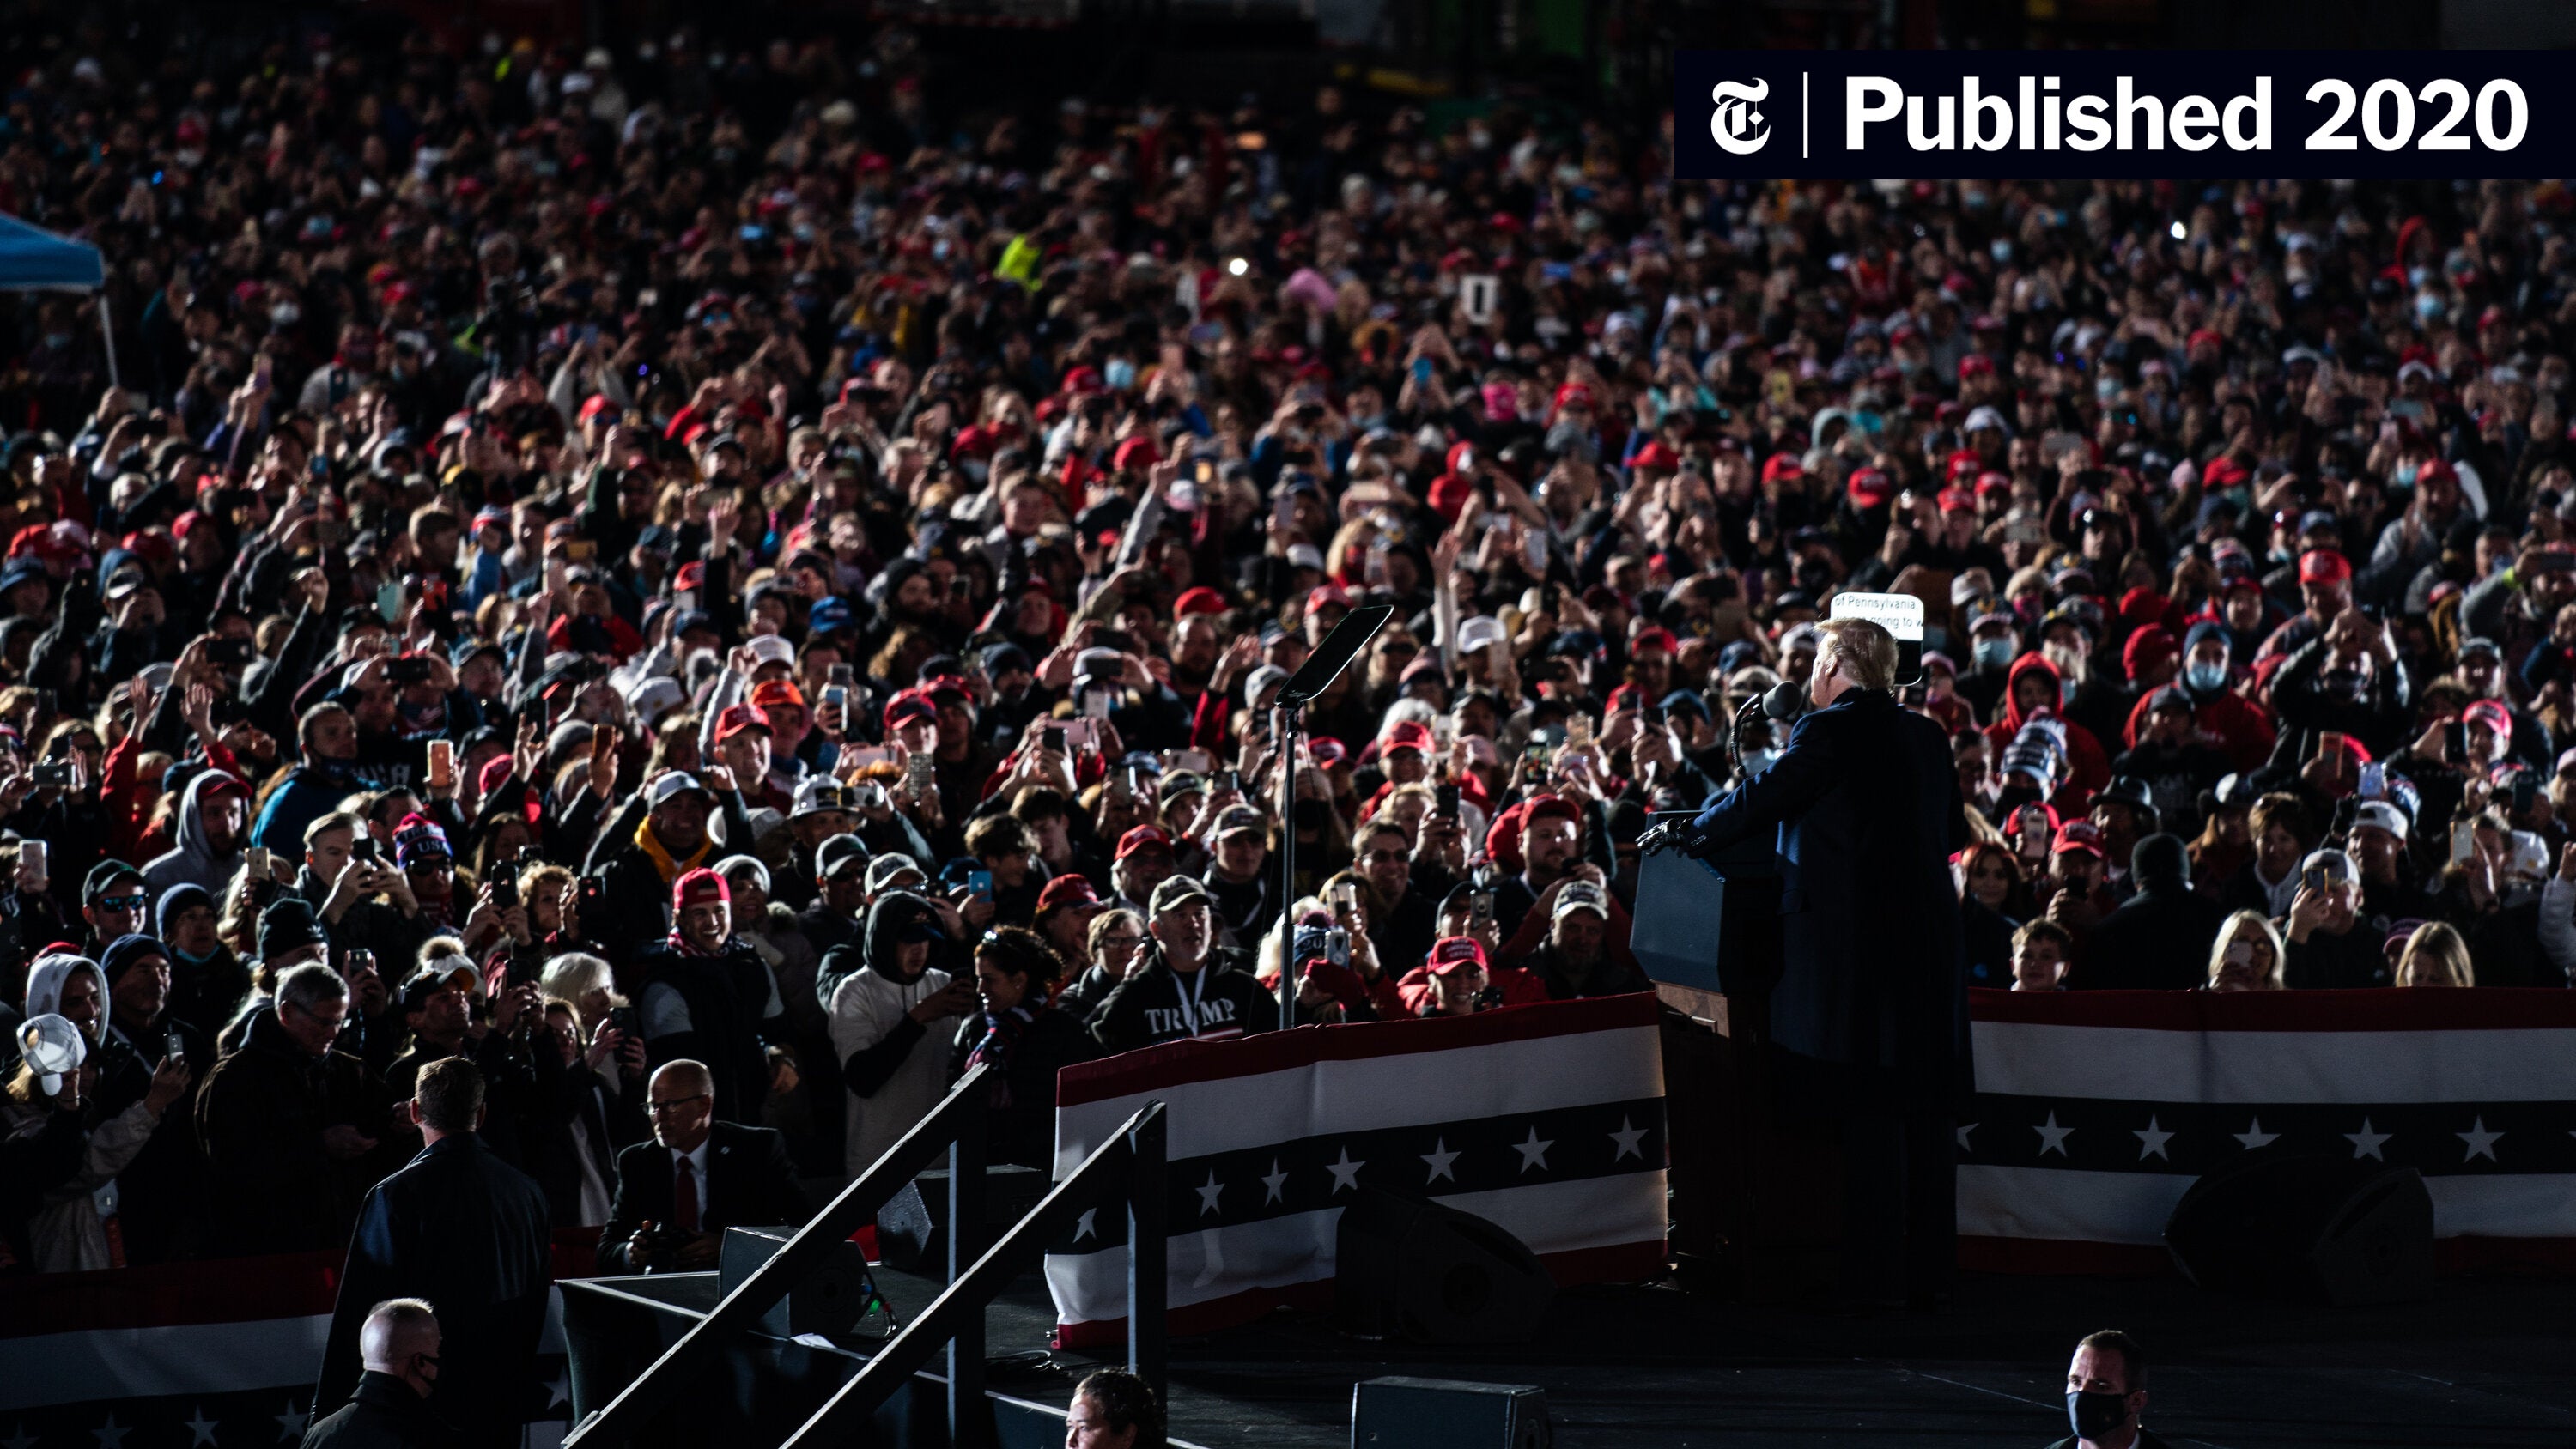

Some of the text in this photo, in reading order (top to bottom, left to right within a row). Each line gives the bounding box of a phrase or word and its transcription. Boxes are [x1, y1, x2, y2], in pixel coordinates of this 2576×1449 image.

[1835, 595, 1845, 606] of
[1903, 616, 1912, 627] to
[417, 840, 445, 853] US
